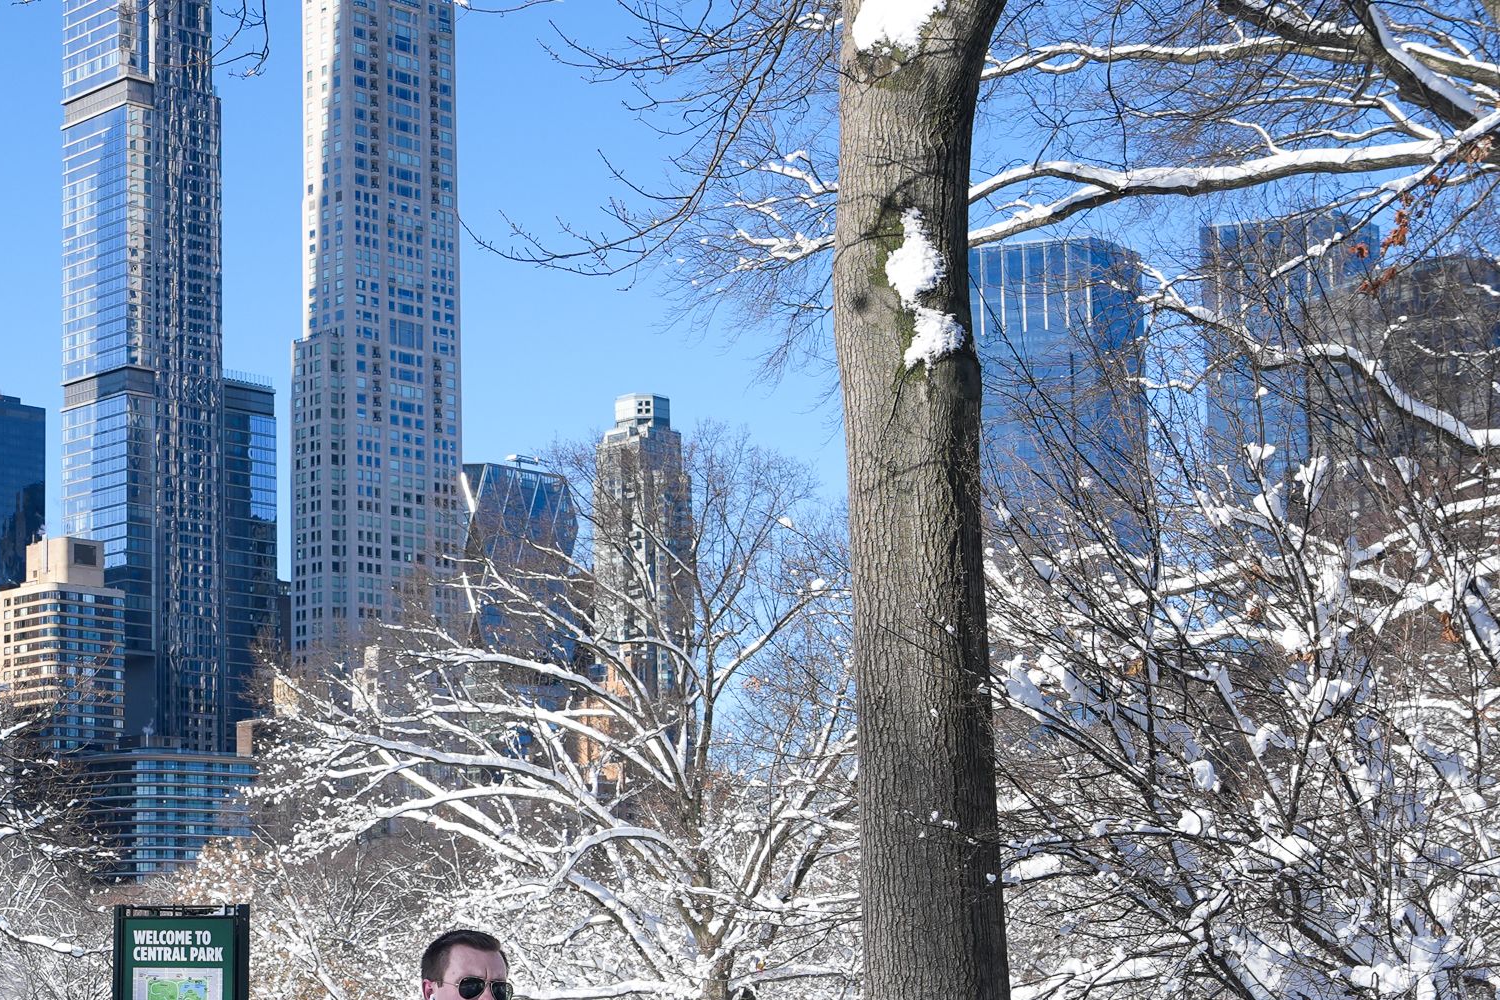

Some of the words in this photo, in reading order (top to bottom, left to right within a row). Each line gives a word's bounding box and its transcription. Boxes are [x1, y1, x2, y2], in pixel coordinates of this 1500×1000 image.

[133, 930, 192, 945] WELCOME
[195, 930, 211, 945] TO
[133, 947, 187, 962] CENTRAL
[190, 947, 223, 962] PARK
